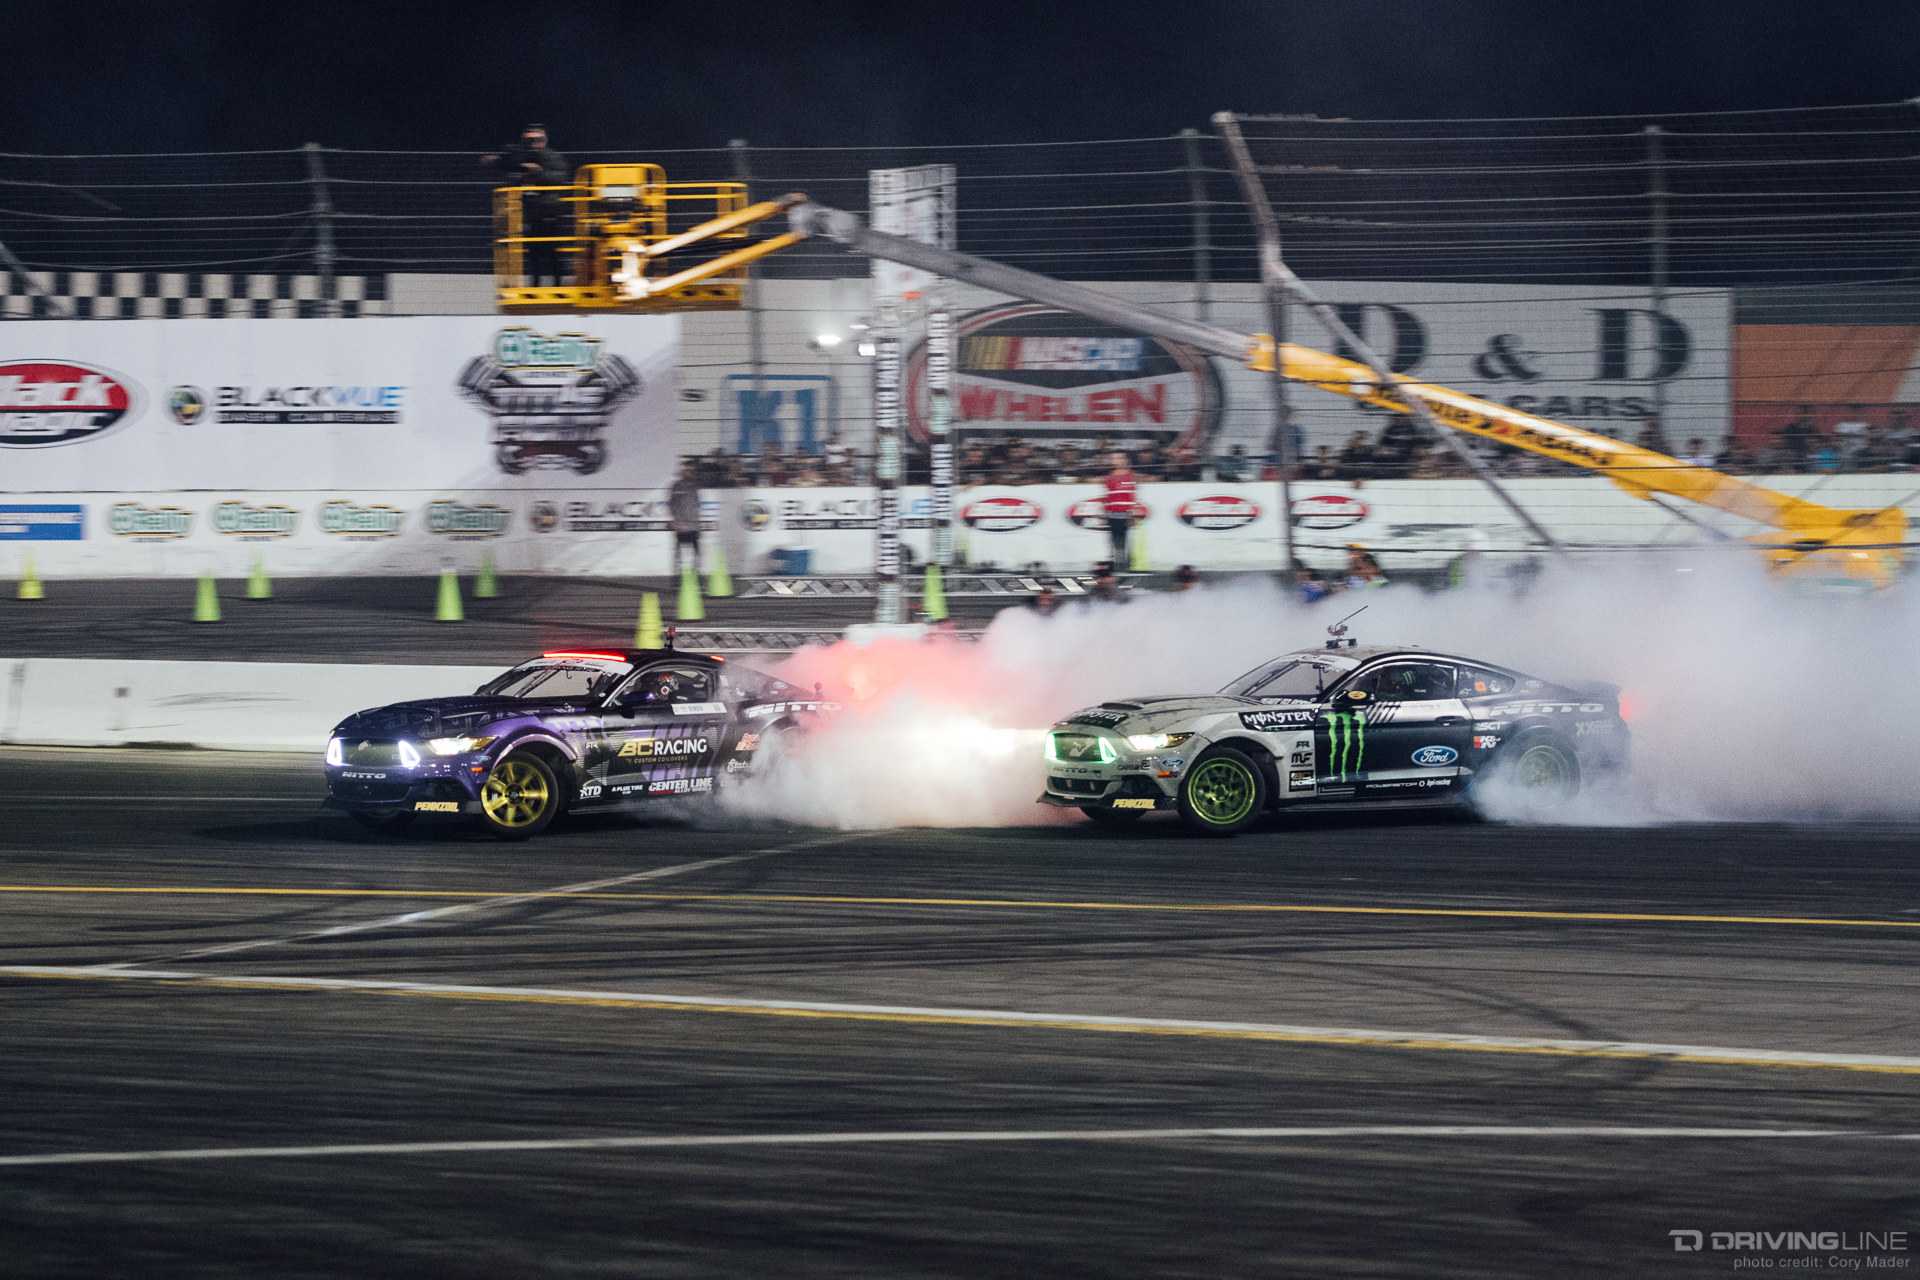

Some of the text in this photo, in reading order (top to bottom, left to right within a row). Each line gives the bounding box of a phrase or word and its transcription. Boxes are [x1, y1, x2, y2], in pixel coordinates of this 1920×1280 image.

[1473, 334, 1542, 381] &
[1588, 308, 1691, 380] D
[959, 384, 1165, 422] WHELEN
[744, 702, 842, 718] NITTO
[1490, 703, 1604, 717] NITTO
[1243, 711, 1314, 725] MONSTER
[618, 738, 707, 757] BC RACING
[1420, 749, 1449, 762] Ford
[342, 771, 387, 779] NITTO
[649, 779, 688, 791] CENTER
[690, 777, 713, 788] LINE
